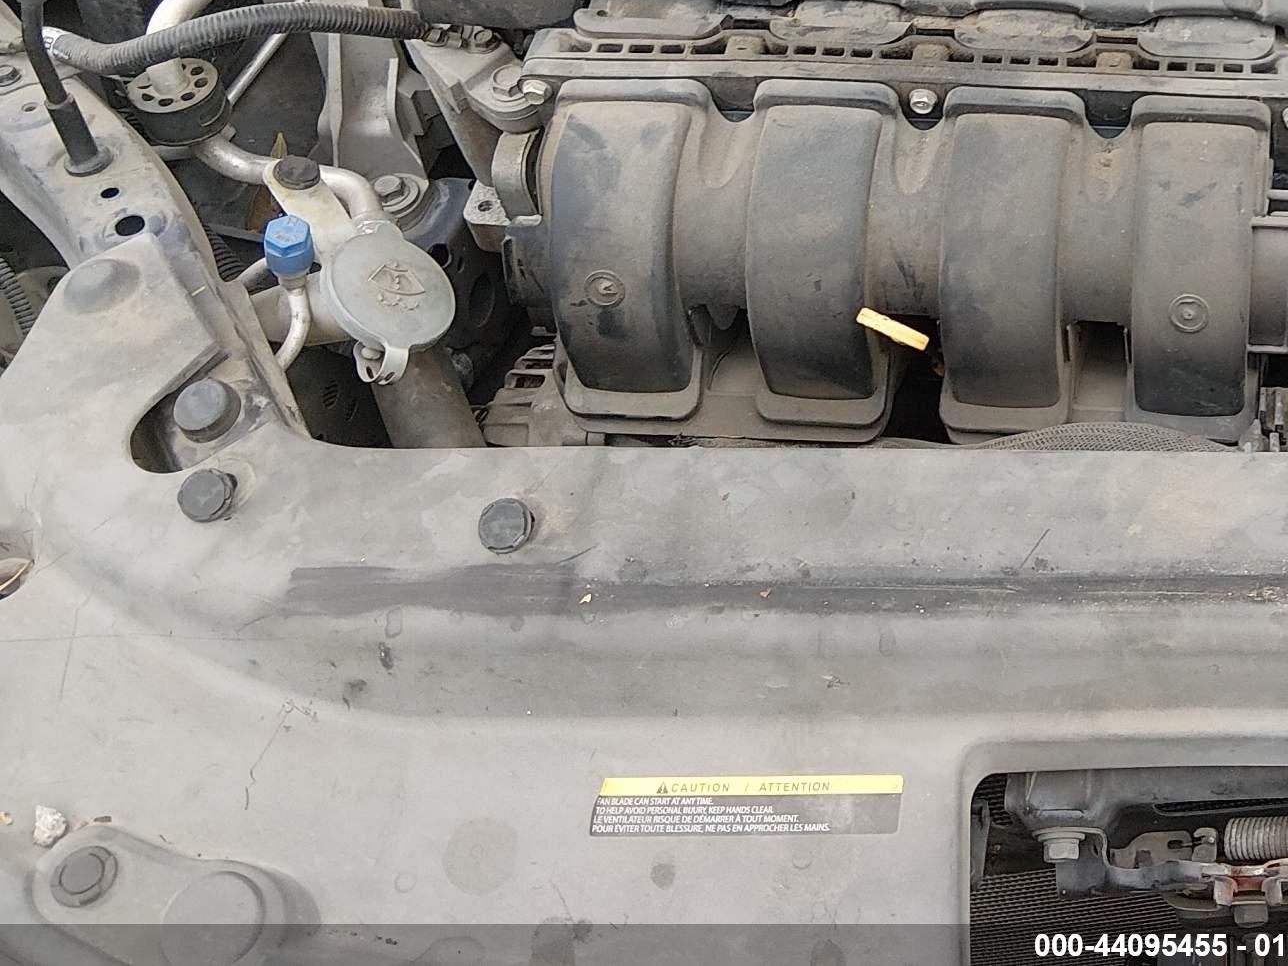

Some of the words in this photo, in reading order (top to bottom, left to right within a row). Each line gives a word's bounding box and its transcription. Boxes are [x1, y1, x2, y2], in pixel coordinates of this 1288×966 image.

[671, 782, 731, 793] CAUTION
[758, 781, 831, 792] ATTENTION
[598, 797, 610, 806] FAN
[611, 797, 634, 806] BLADE
[634, 797, 649, 806] CAN
[650, 797, 670, 806] START
[671, 797, 680, 806] AT
[680, 797, 696, 806] ANY
[696, 797, 714, 806] TIME.
[595, 807, 606, 815] TO
[606, 807, 624, 815] HELP
[624, 807, 646, 815] AVOID
[646, 807, 682, 815] PERSONAL
[708, 806, 725, 814] KEEP
[726, 806, 750, 814] HANDS
[751, 806, 774, 814] CLEAR.
[593, 815, 602, 824] LE
[602, 815, 652, 824] VENTILATEUR
[653, 815, 681, 824] RISQUE
[681, 815, 692, 824] DE
[693, 814, 734, 823] DÉMARRER
[742, 814, 763, 823] TOUT
[763, 814, 800, 823] MOMENT.
[591, 825, 615, 833] POUR
[615, 825, 640, 833] ÉVITER
[640, 824, 665, 833] TOUTE
[665, 824, 704, 833] BLESSURE,
[705, 824, 717, 832] NE
[717, 824, 731, 832] PAS
[732, 824, 743, 832] EN
[743, 824, 789, 832] APPROCHER
[789, 823, 803, 832] LES
[803, 823, 831, 832] MAINS.
